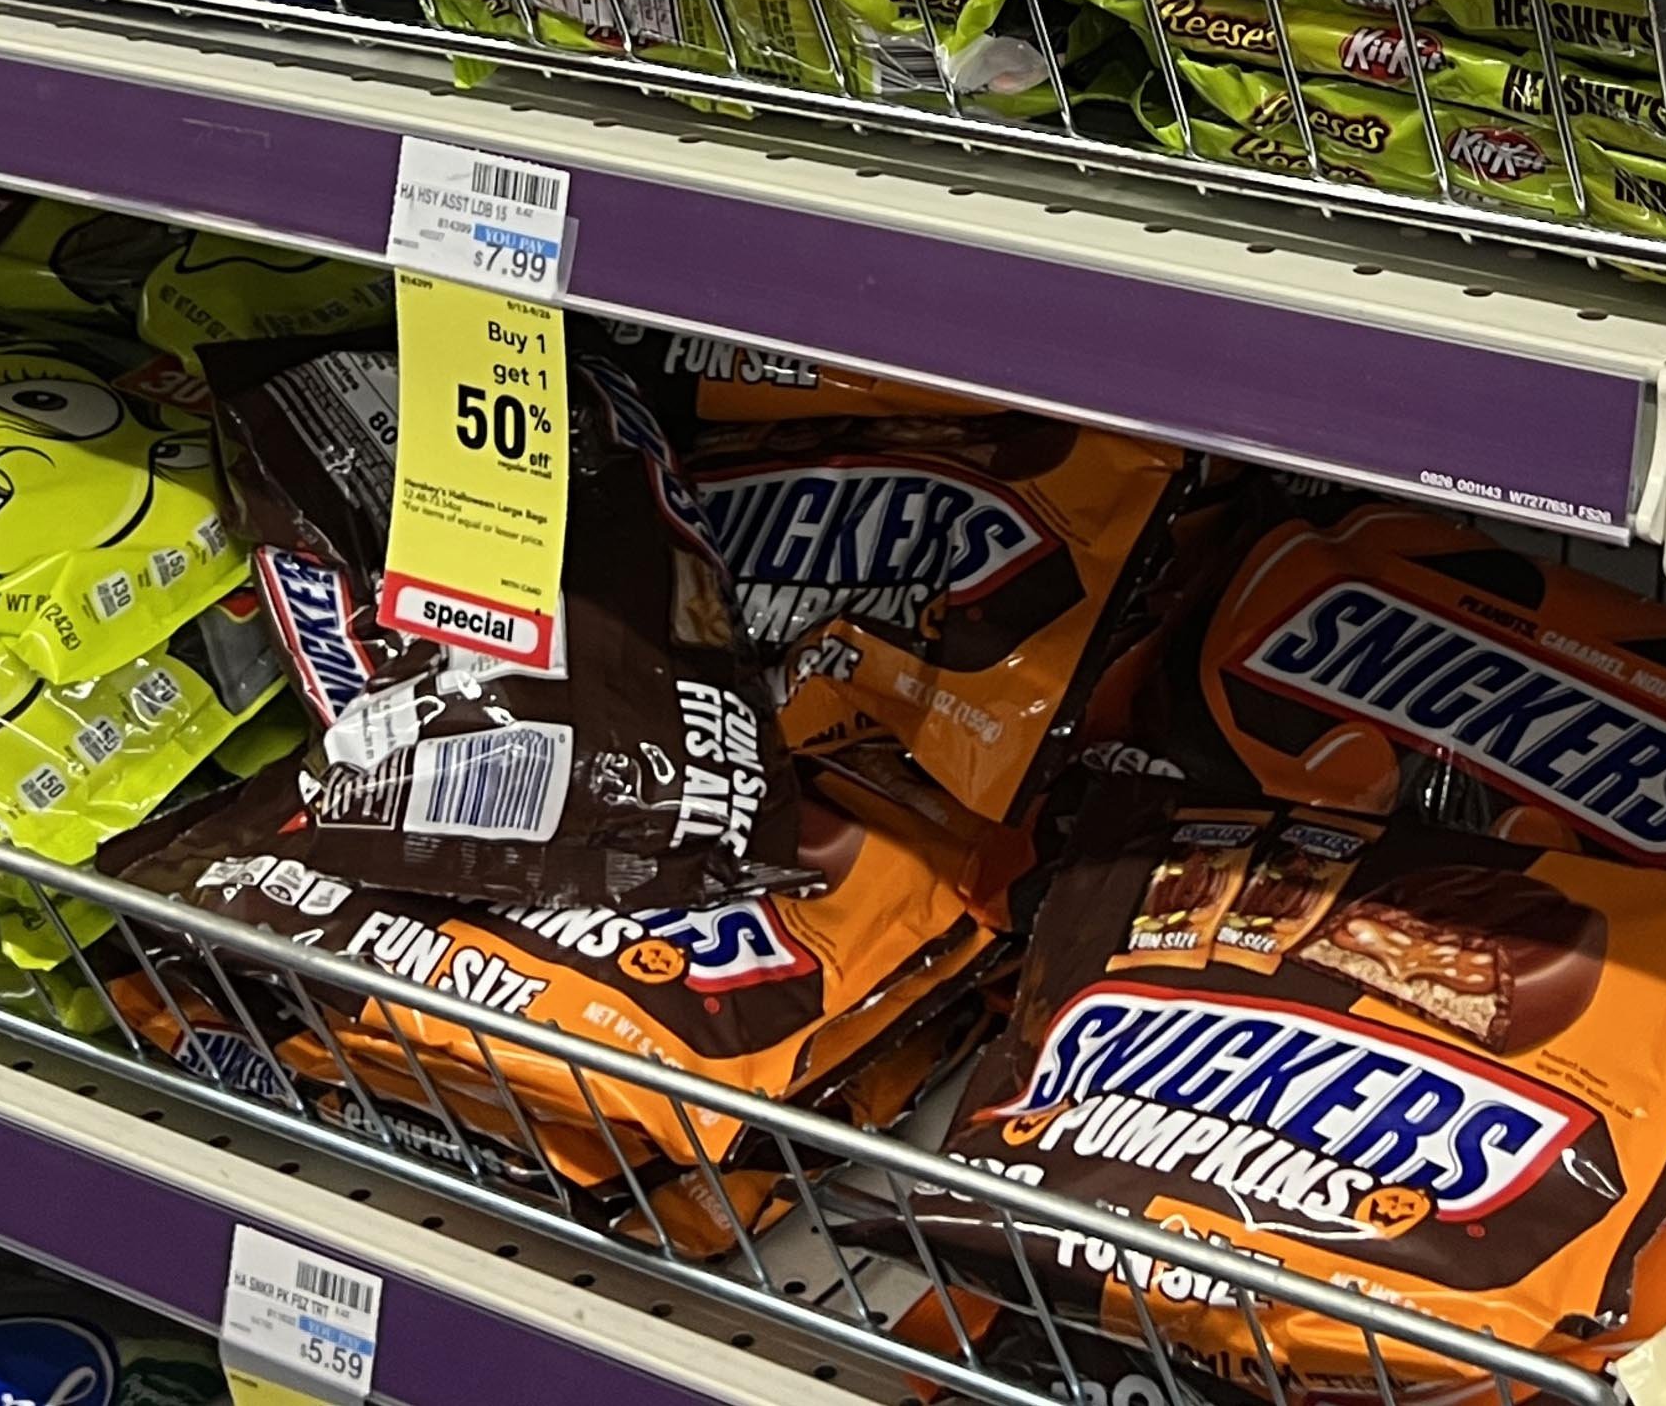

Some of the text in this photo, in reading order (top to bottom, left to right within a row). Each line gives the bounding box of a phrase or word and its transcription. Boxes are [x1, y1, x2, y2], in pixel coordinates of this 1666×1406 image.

[1448, 129, 1547, 181] KitKat
[417, 187, 493, 219] HSY ASST LDB
[473, 242, 547, 283] $7.99
[487, 320, 546, 355] Buy 1
[663, 337, 733, 383] FUN
[492, 363, 548, 391] get 1
[456, 383, 553, 461] 50%
[496, 501, 524, 520] Large
[2, 593, 29, 615] WT
[421, 599, 516, 644] special
[723, 690, 762, 767] FUN
[670, 680, 731, 849] FITS ALL
[347, 911, 548, 1014] FUN SIZE
[1164, 931, 1201, 951] SIZE
[1035, 1004, 1544, 1204] SNICKERS
[1037, 1094, 1375, 1222] PUMPKINS
[299, 1336, 364, 1381] $5.59
